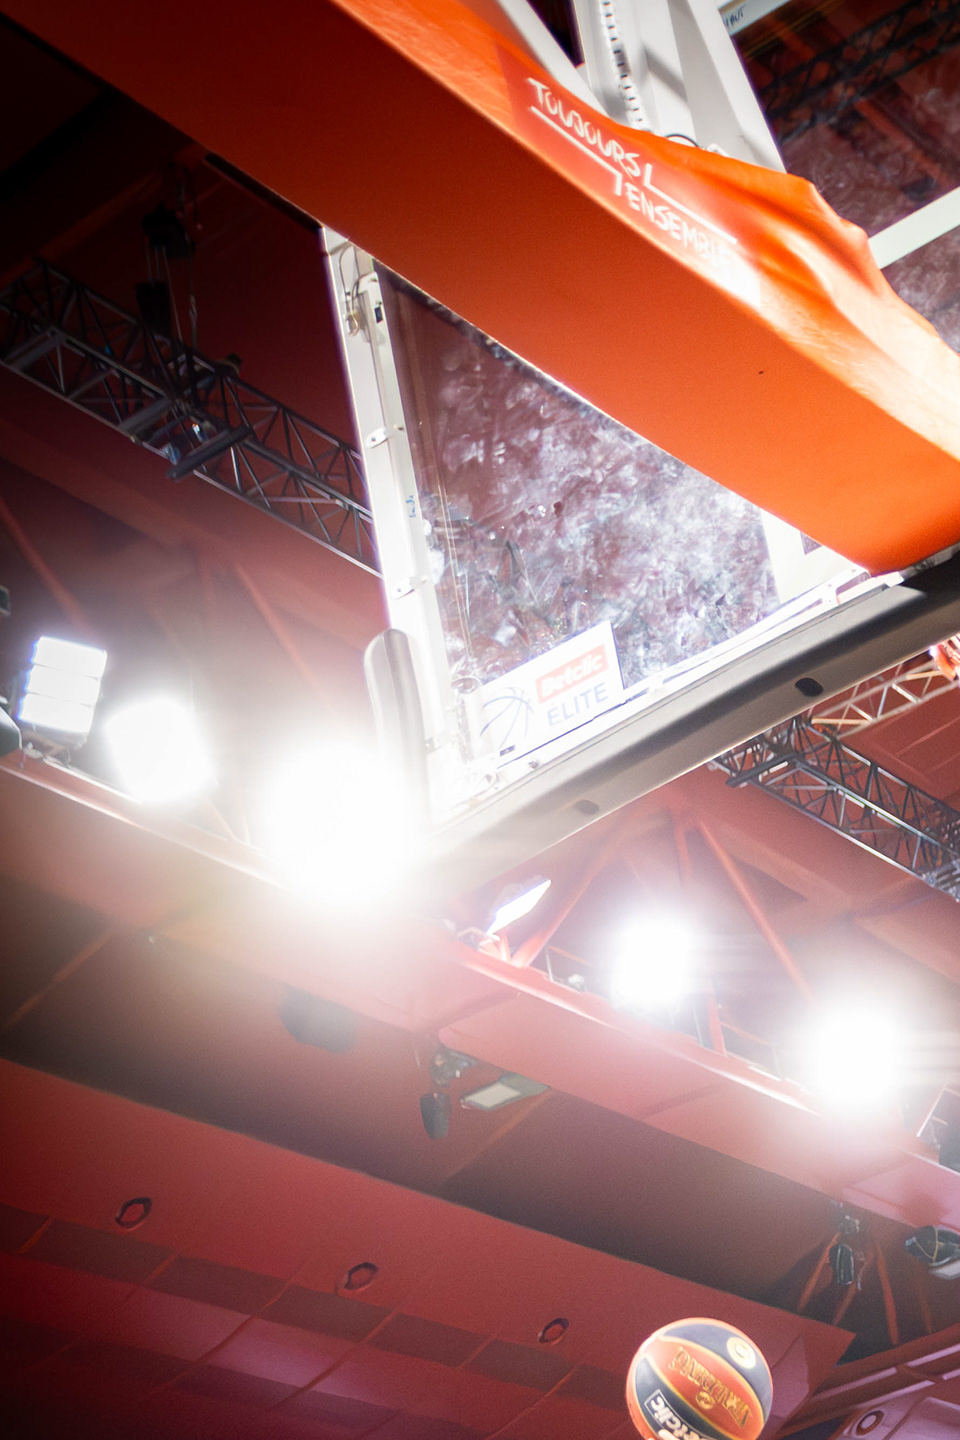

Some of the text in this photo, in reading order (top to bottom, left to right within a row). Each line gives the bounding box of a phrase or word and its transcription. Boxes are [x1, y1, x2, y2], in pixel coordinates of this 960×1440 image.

[528, 77, 641, 178] TOUJOURS
[541, 651, 605, 697] Betclic
[546, 682, 609, 727] ELITE
